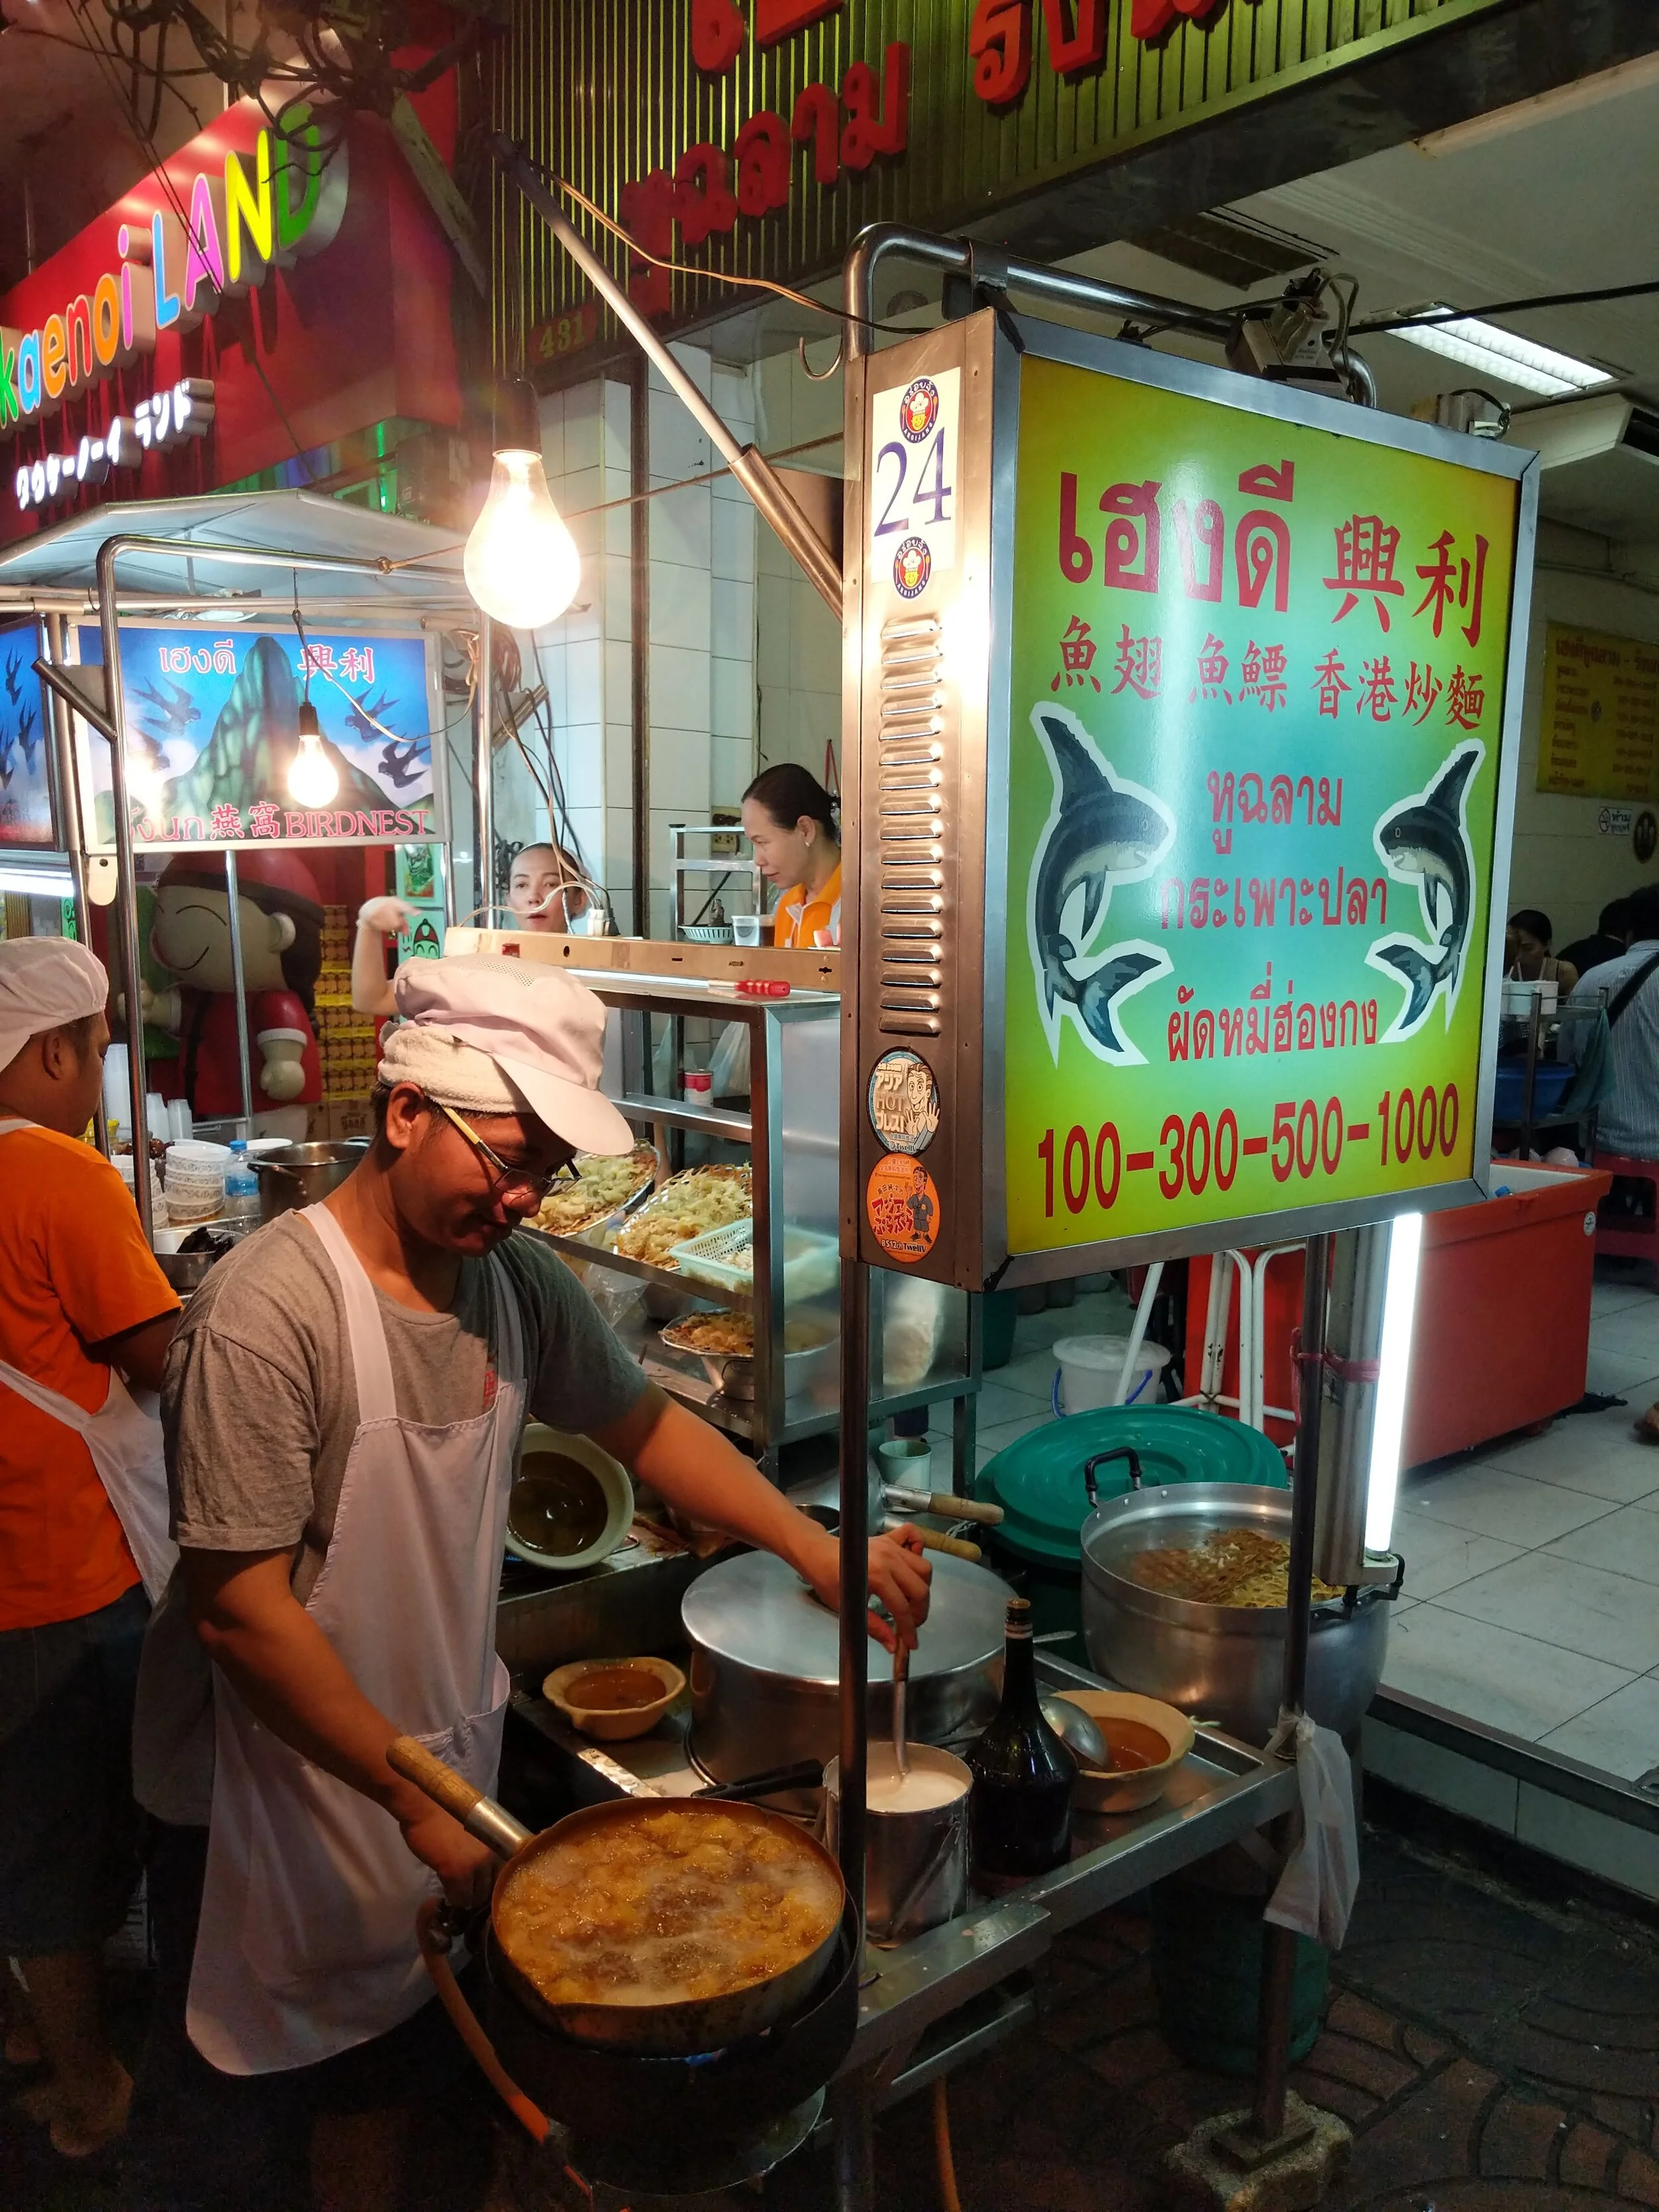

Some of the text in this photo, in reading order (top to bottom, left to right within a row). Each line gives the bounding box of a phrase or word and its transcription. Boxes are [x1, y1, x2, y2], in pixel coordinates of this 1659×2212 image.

[151, 103, 323, 330] LAND
[539, 311, 586, 358] 431
[903, 422, 933, 441] AROIJANG
[873, 427, 952, 537] 24
[1058, 459, 1490, 648] เฮงดี 興利
[897, 581, 926, 597] AROIJANG
[159, 638, 376, 684] เฮงดี 興利
[1050, 615, 1162, 701] 魚翅
[1188, 632, 1288, 713] 魚鰾
[1309, 648, 1485, 729] 香港炒麵
[210, 800, 281, 842] 燕窩
[284, 809, 432, 839] BIRDNEST
[1206, 769, 1343, 854] หูฉลาม
[1159, 865, 1388, 930] กระเพาะปลา
[1167, 961, 1378, 1063] ผัดหมี่ฮ่องกง
[875, 1072, 903, 1091] アジア
[875, 1091, 905, 1112] HOT
[1037, 1082, 1459, 1218] 100-300-500-1000
[881, 1238, 926, 1252] BS12ch TwellV
